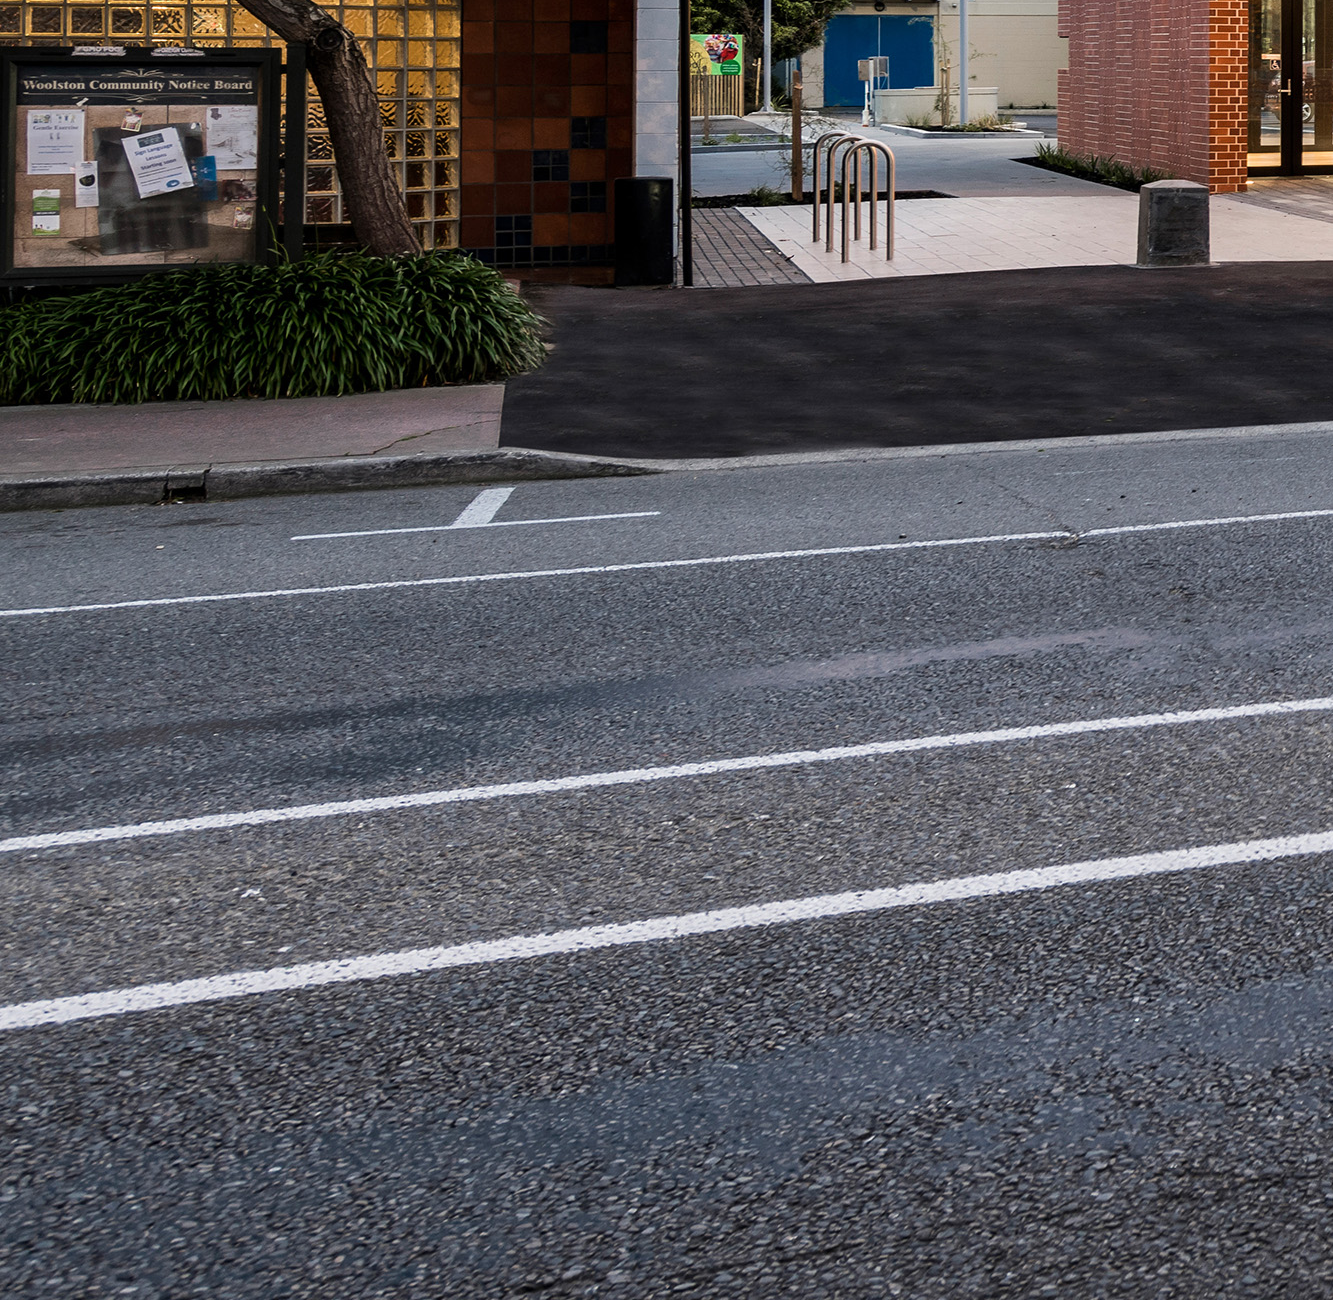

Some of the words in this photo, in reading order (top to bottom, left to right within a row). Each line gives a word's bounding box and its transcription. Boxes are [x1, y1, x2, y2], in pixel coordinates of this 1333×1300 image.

[23, 80, 85, 91] Woolston
[89, 80, 165, 92] Community
[168, 80, 210, 91] Notice
[214, 80, 253, 91] Board
[147, 143, 173, 153] Language
[140, 161, 163, 170] Starting
